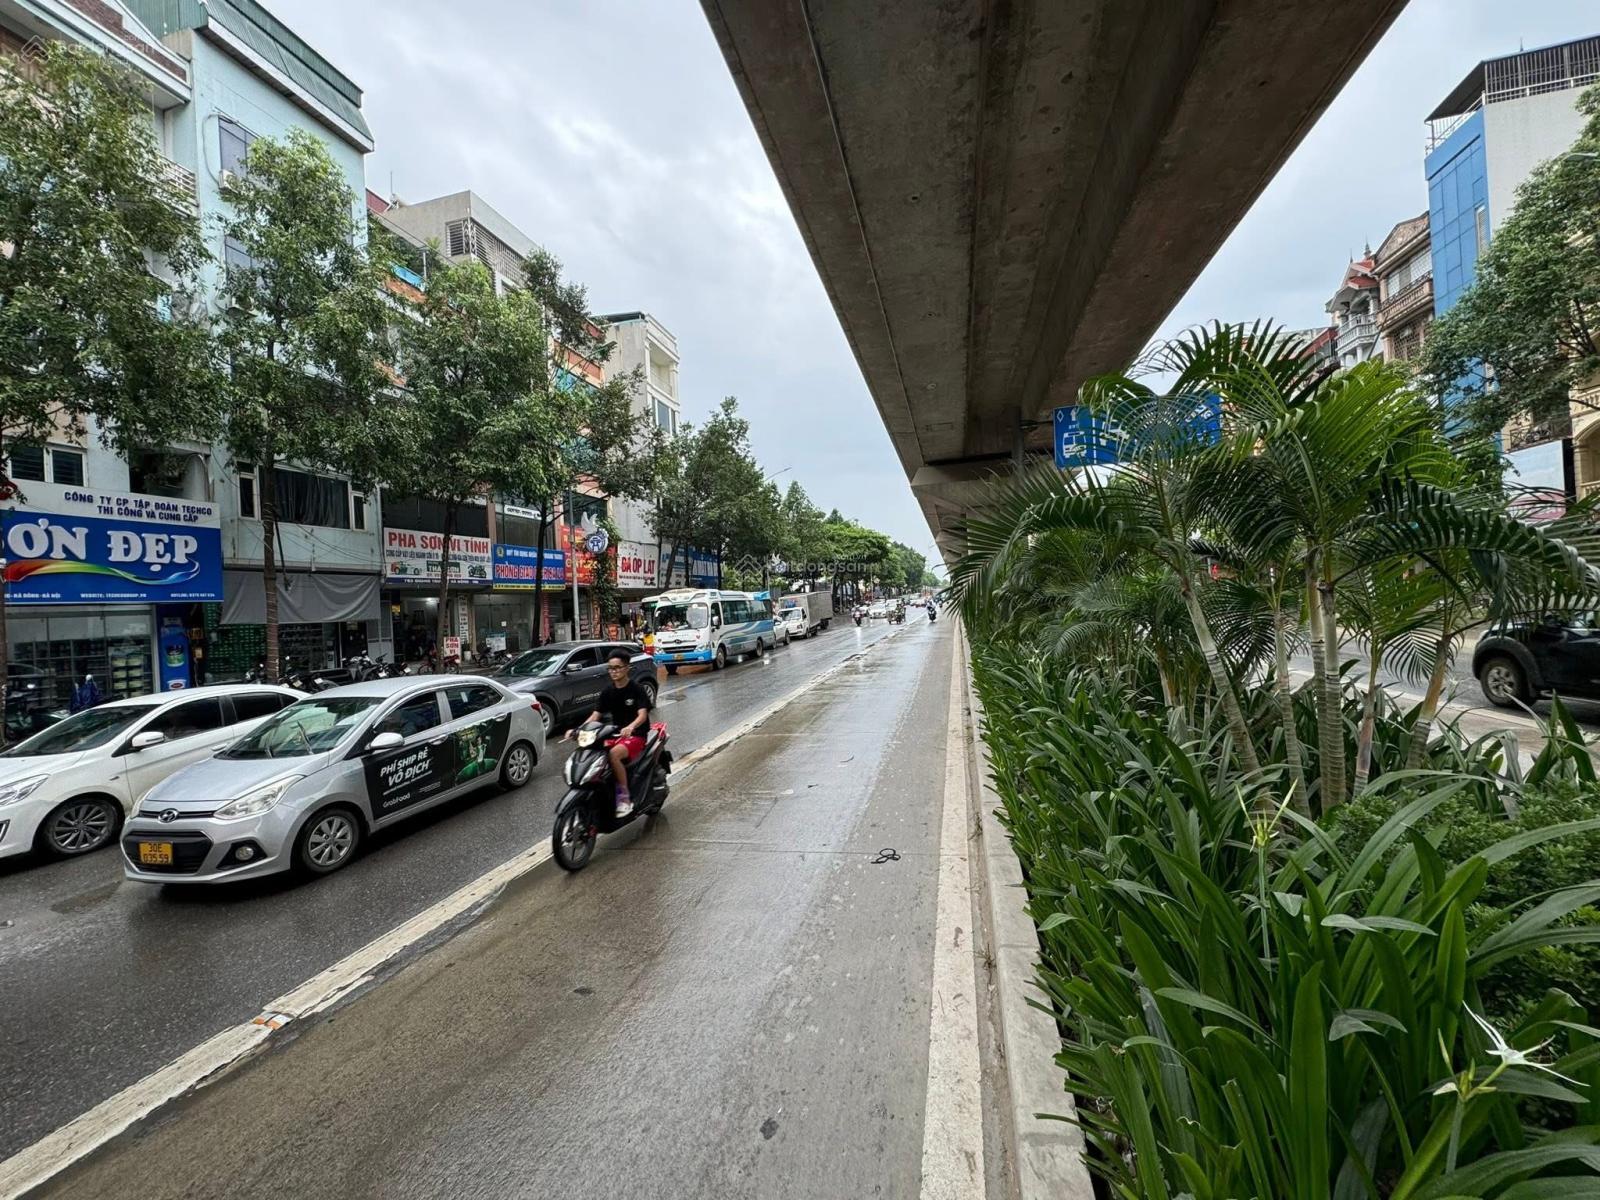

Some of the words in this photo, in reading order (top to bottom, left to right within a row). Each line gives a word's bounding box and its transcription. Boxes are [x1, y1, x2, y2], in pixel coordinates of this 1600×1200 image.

[64, 491, 94, 503] CÔNG
[100, 496, 112, 505] TY
[116, 497, 129, 507] CP
[181, 505, 212, 516] TECHCO
[97, 505, 113, 515] THI
[117, 506, 143, 518] CÔNG
[146, 509, 157, 519] VÀ
[158, 511, 181, 521] CUNG
[2, 518, 89, 560] ƠN
[107, 530, 199, 572] ĐẸP
[388, 531, 417, 548] PHA
[420, 534, 444, 551] SƠN
[463, 537, 489, 553] TÍNH
[495, 561, 518, 579] PHÒNG
[380, 759, 398, 777] PHÍ
[397, 754, 417, 770] SHIP
[388, 768, 404, 786] VÔ
[404, 759, 431, 779] ĐỊCH
